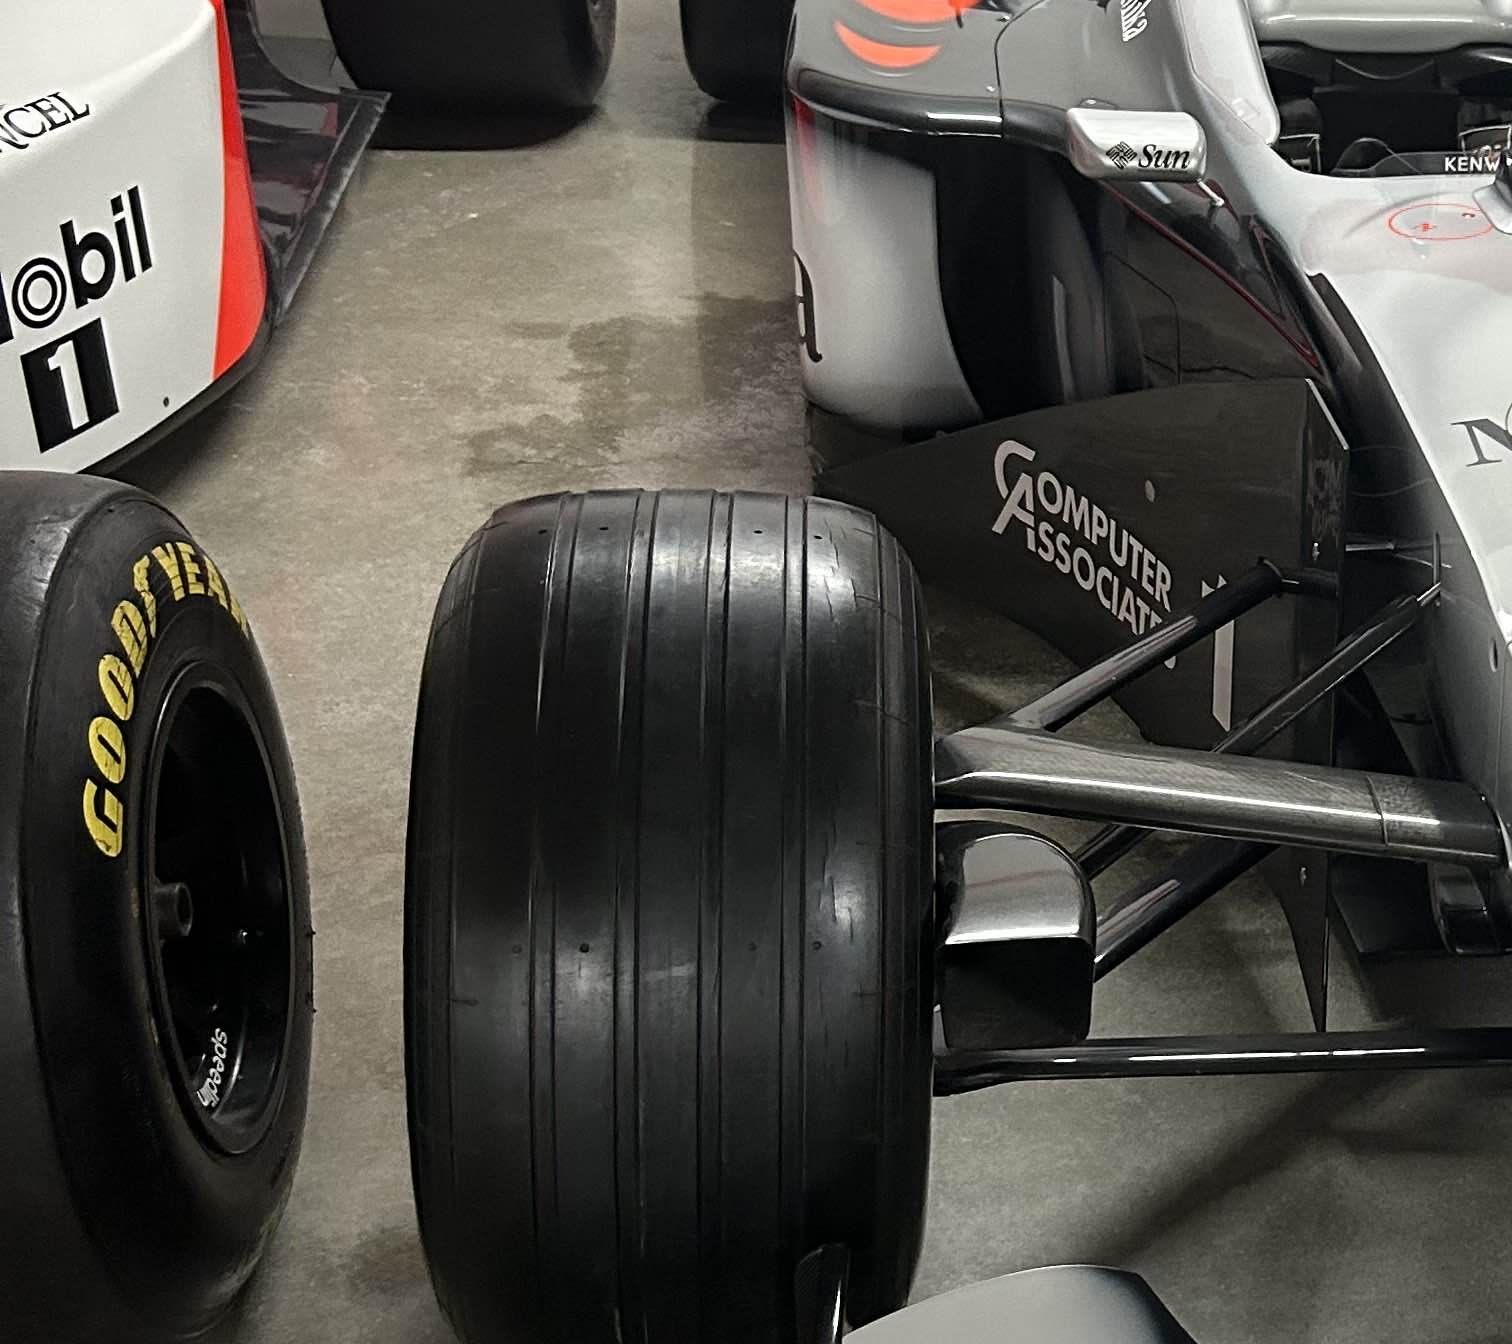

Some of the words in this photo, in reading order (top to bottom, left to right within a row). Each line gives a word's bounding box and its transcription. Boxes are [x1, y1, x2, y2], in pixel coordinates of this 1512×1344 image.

[1138, 143, 1190, 170] Sun
[0, 184, 153, 344] obil
[83, 542, 249, 857] GOODYEAR
